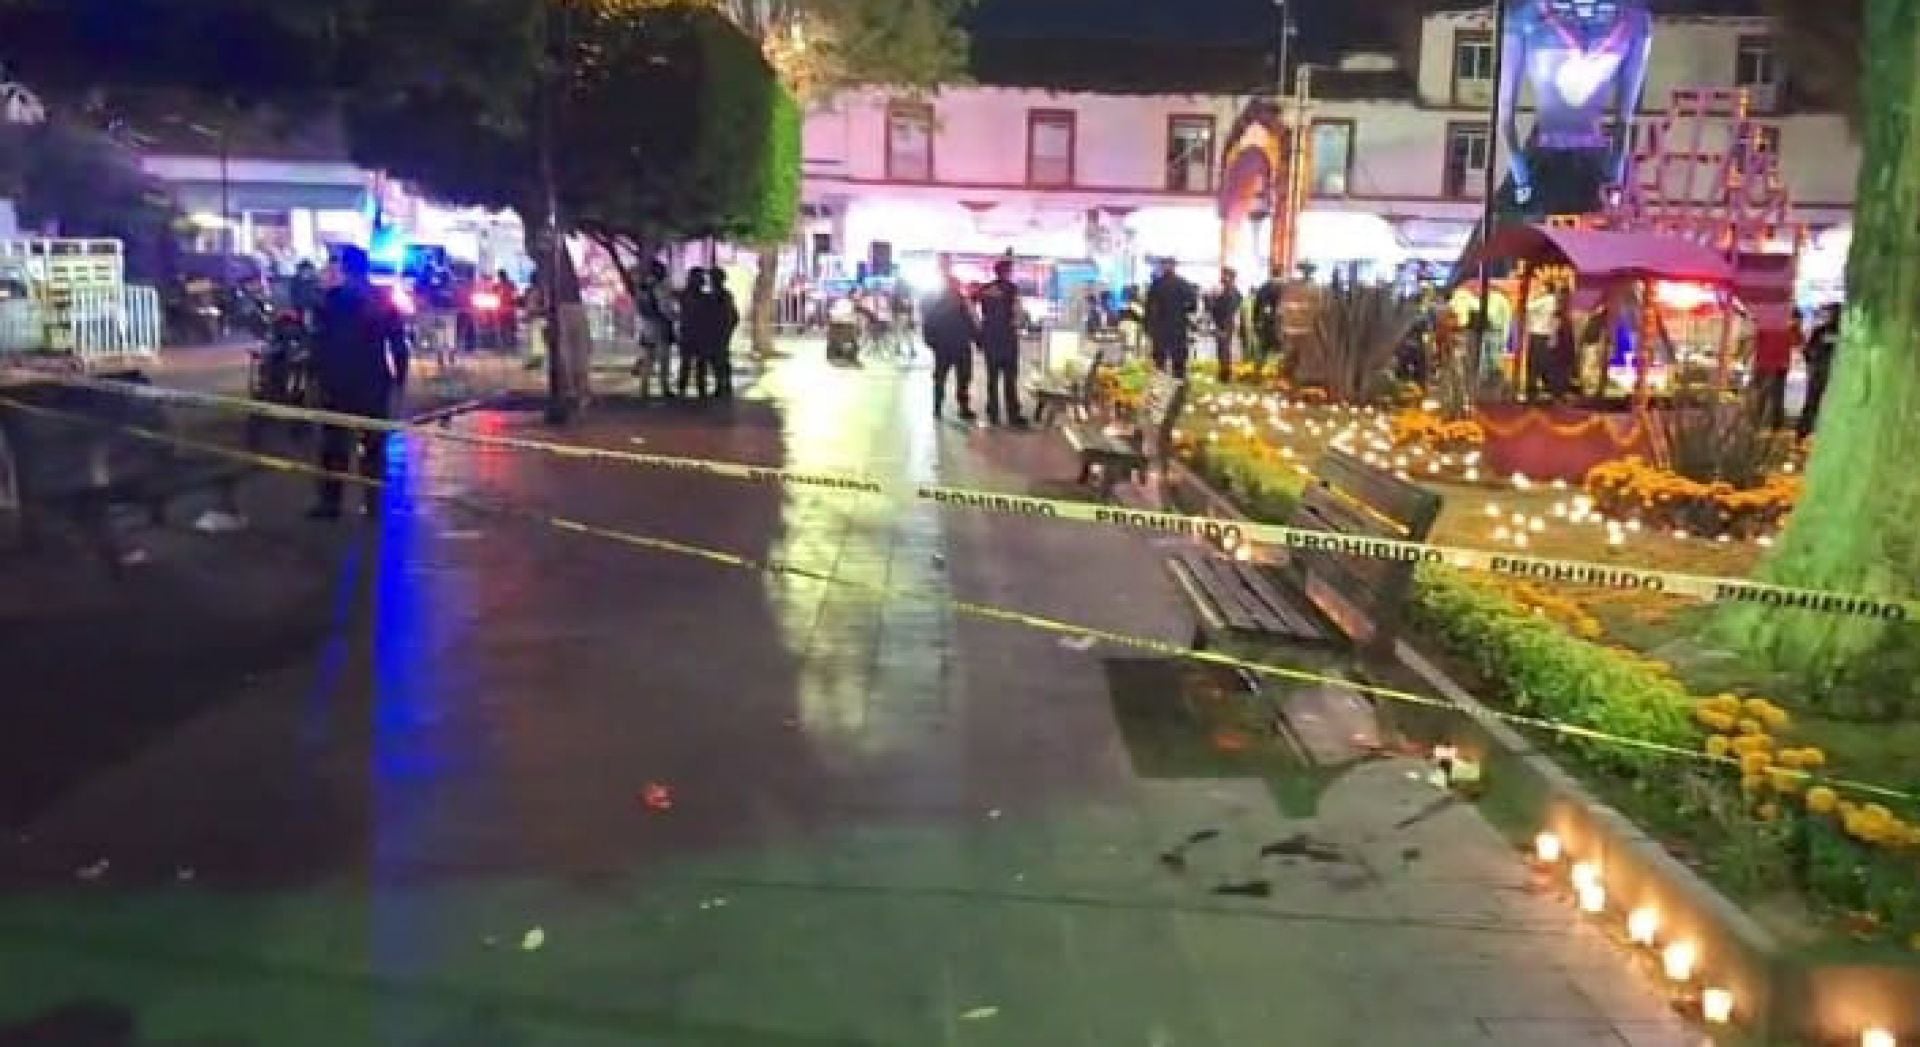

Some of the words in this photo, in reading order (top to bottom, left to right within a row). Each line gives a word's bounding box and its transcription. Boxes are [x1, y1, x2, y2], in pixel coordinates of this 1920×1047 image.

[1095, 510, 1241, 540] PROHIBIDO
[1285, 532, 1443, 562] PROHIBIDO
[1490, 556, 1664, 591] PROHIBIDO
[1716, 584, 1905, 621] PROHIBIDO
